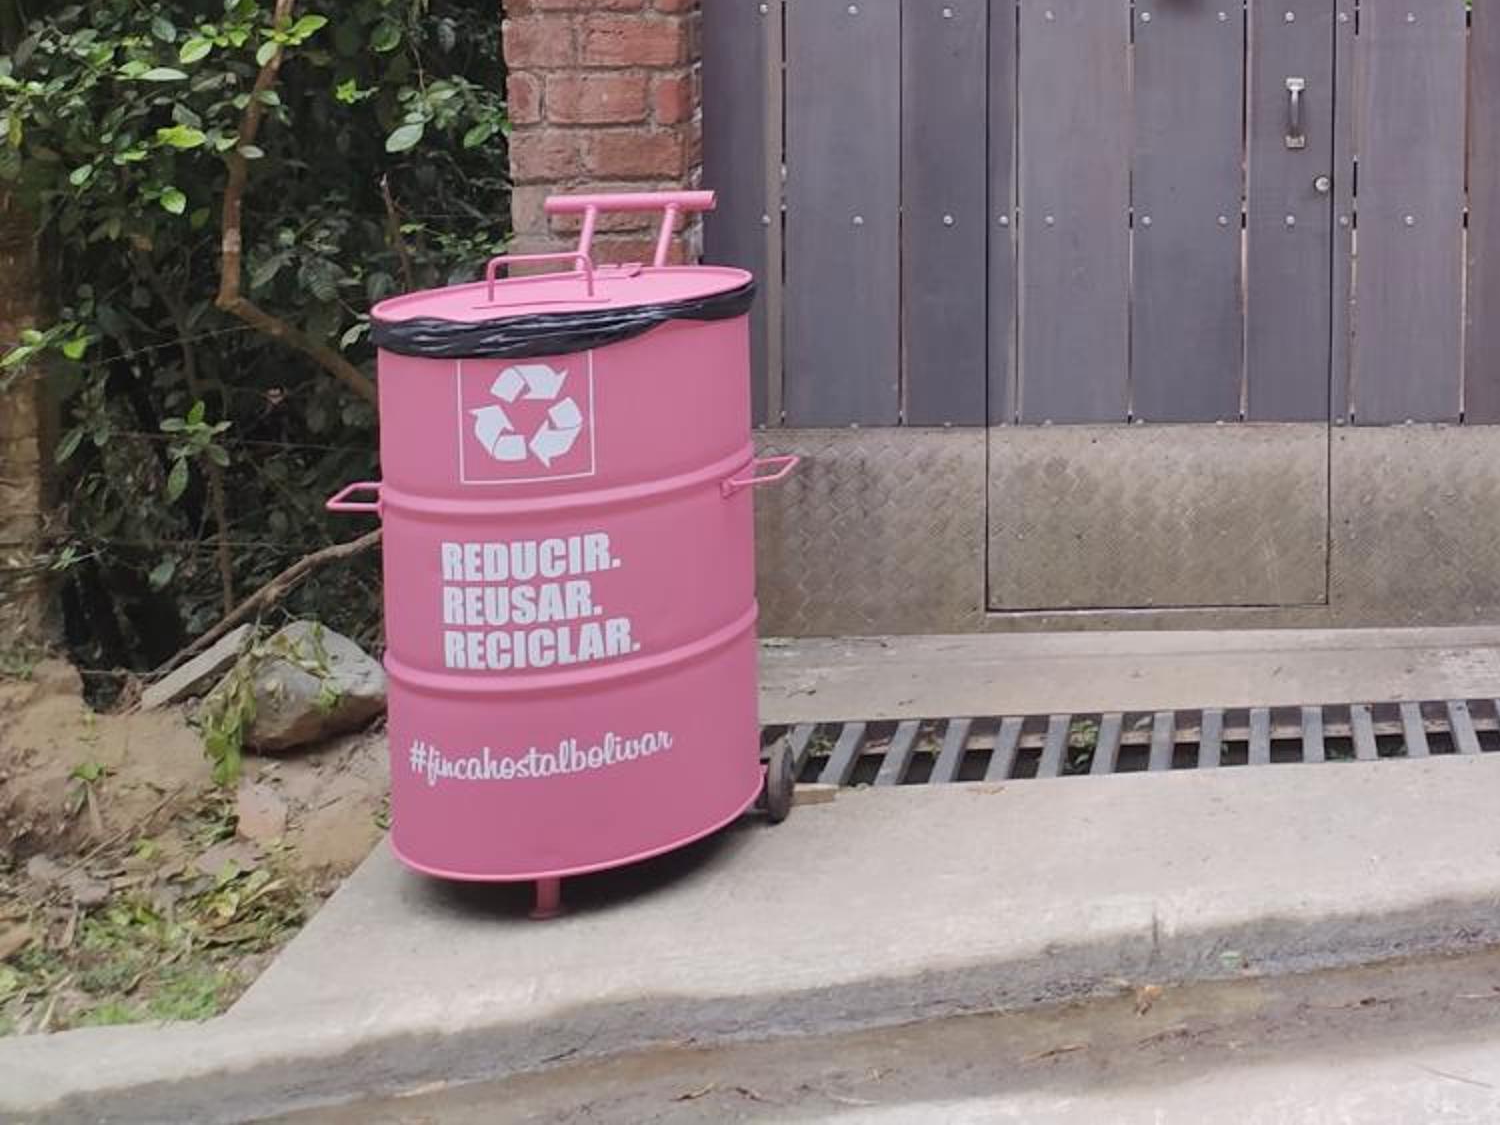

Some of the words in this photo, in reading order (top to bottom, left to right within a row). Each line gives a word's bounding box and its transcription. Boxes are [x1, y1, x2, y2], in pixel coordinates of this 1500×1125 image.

[441, 532, 621, 581] REDUCIR.
[443, 579, 602, 626] REUSAR.
[444, 618, 641, 669] RECICLAR.
[409, 730, 673, 787] #fincahostalbolivar
